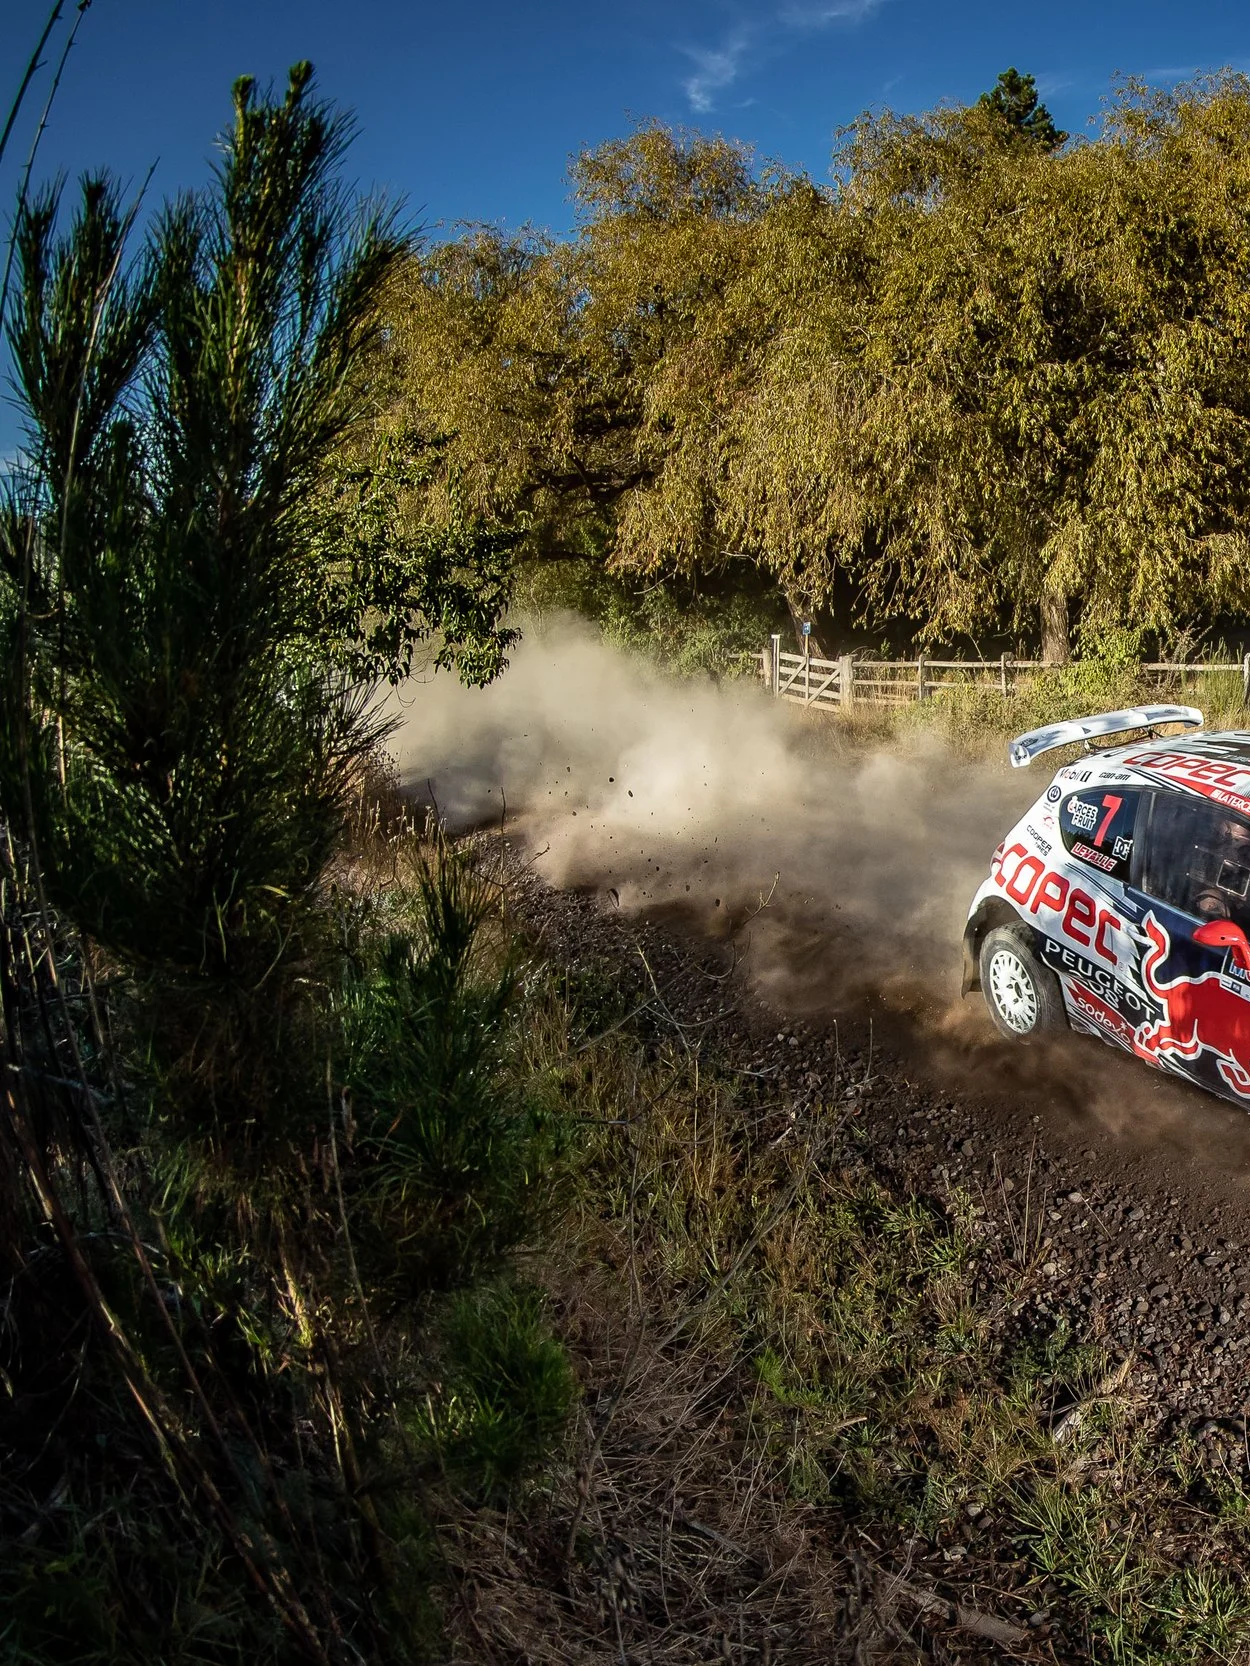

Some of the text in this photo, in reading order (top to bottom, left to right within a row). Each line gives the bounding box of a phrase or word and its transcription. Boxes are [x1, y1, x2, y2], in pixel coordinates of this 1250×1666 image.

[1060, 768, 1082, 781] Mobil
[1099, 771, 1131, 782] can-am
[1073, 814, 1097, 830] FRUIT
[1094, 795, 1123, 847] 7
[1026, 824, 1052, 852] COOPER
[1034, 841, 1049, 857] TIRES
[1045, 938, 1155, 1020] PEUGEOT
[1069, 969, 1119, 1009] 208
[1076, 997, 1131, 1043] sodexo
